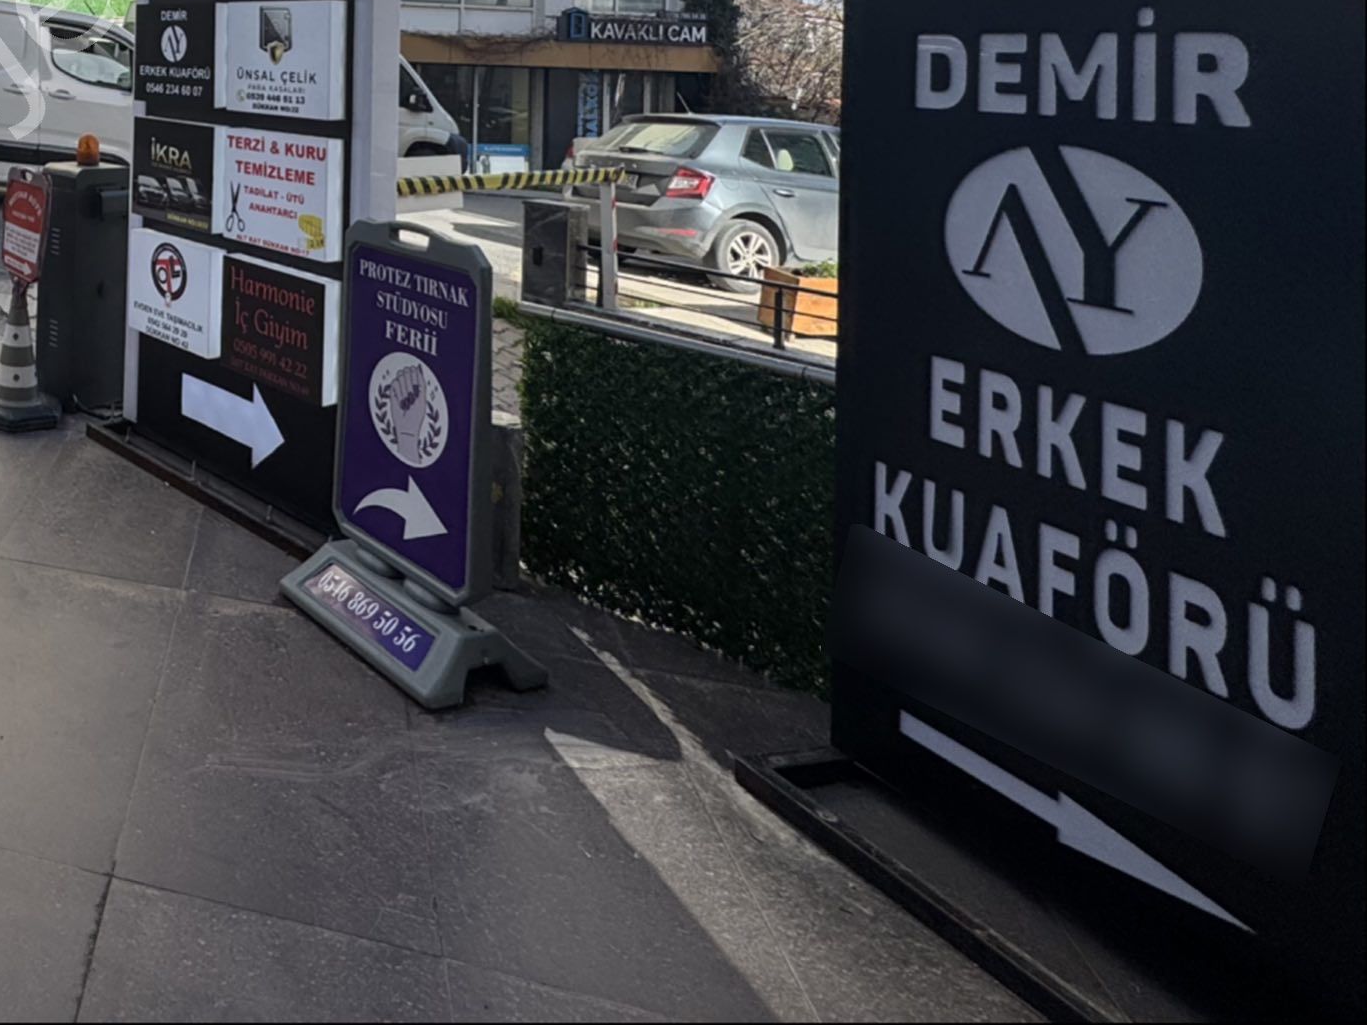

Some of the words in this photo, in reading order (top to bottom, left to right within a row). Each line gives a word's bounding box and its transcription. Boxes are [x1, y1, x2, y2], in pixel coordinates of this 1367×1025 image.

[160, 7, 188, 22] DEMİR
[590, 21, 664, 41] KAVAKLI
[667, 25, 707, 43] CAM
[139, 64, 168, 77] ERKEK
[169, 65, 211, 80] KUAFÖRÜ
[236, 66, 275, 82] ÜNSAL
[280, 69, 317, 85] ÇELİK
[914, 6, 1252, 128] DEMİR
[151, 136, 193, 170] İKRA
[227, 134, 265, 153] TERZİ
[269, 139, 280, 155] &
[284, 141, 327, 162] KURU
[235, 160, 316, 186] TEMİZLEME
[243, 184, 279, 200] TADİLAT
[285, 191, 305, 205] ÜTÜ
[248, 202, 299, 220] ANAHTARCI
[229, 264, 316, 316] Harmonie
[359, 258, 412, 290] PROTEZ
[413, 272, 470, 308] TIRNAK
[235, 295, 250, 335] İç
[253, 308, 309, 351] Giyim
[376, 289, 449, 329] STÜDYOSU
[385, 319, 439, 357] FERİİ
[928, 354, 1227, 539] ERKEK
[873, 460, 1318, 732] KUAFÖRÜ
[347, 591, 380, 620] 869
[372, 610, 400, 636] 50
[392, 625, 423, 653] 56
